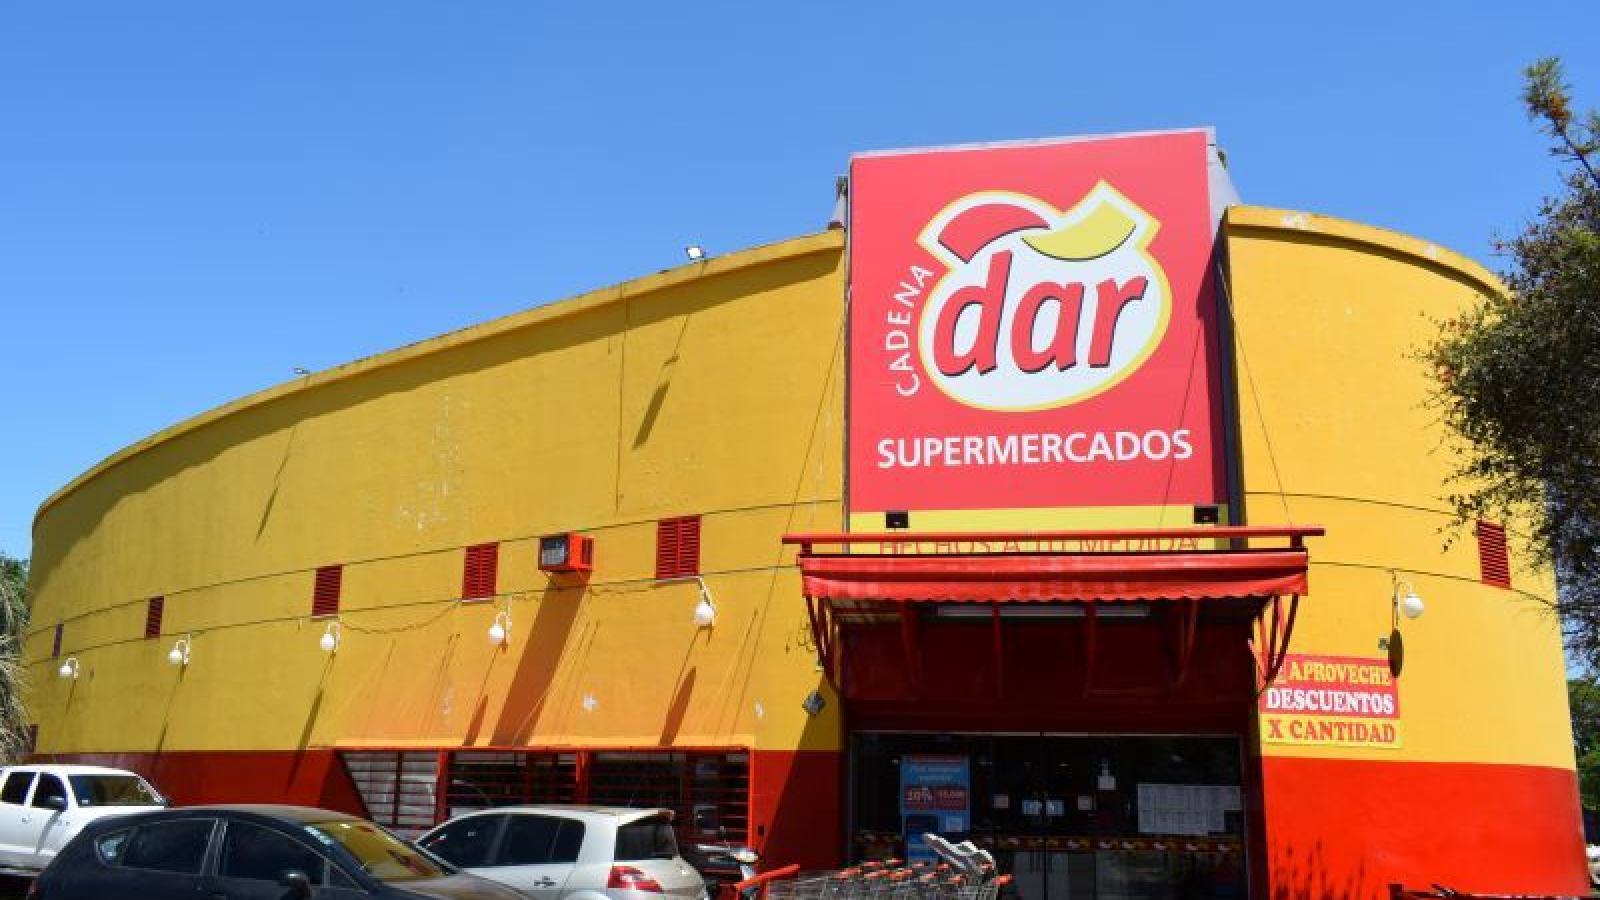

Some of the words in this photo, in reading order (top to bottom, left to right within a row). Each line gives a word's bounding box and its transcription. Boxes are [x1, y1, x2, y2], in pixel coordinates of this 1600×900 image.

[933, 249, 1148, 377] dar
[886, 264, 934, 397] CADENA
[877, 429, 1194, 469] SUPERMERCADOS
[1289, 661, 1391, 686] APROVECHE
[1267, 688, 1395, 714] DESCUENTOS
[1267, 718, 1285, 740] X
[1289, 719, 1397, 743] CANTIDAD
